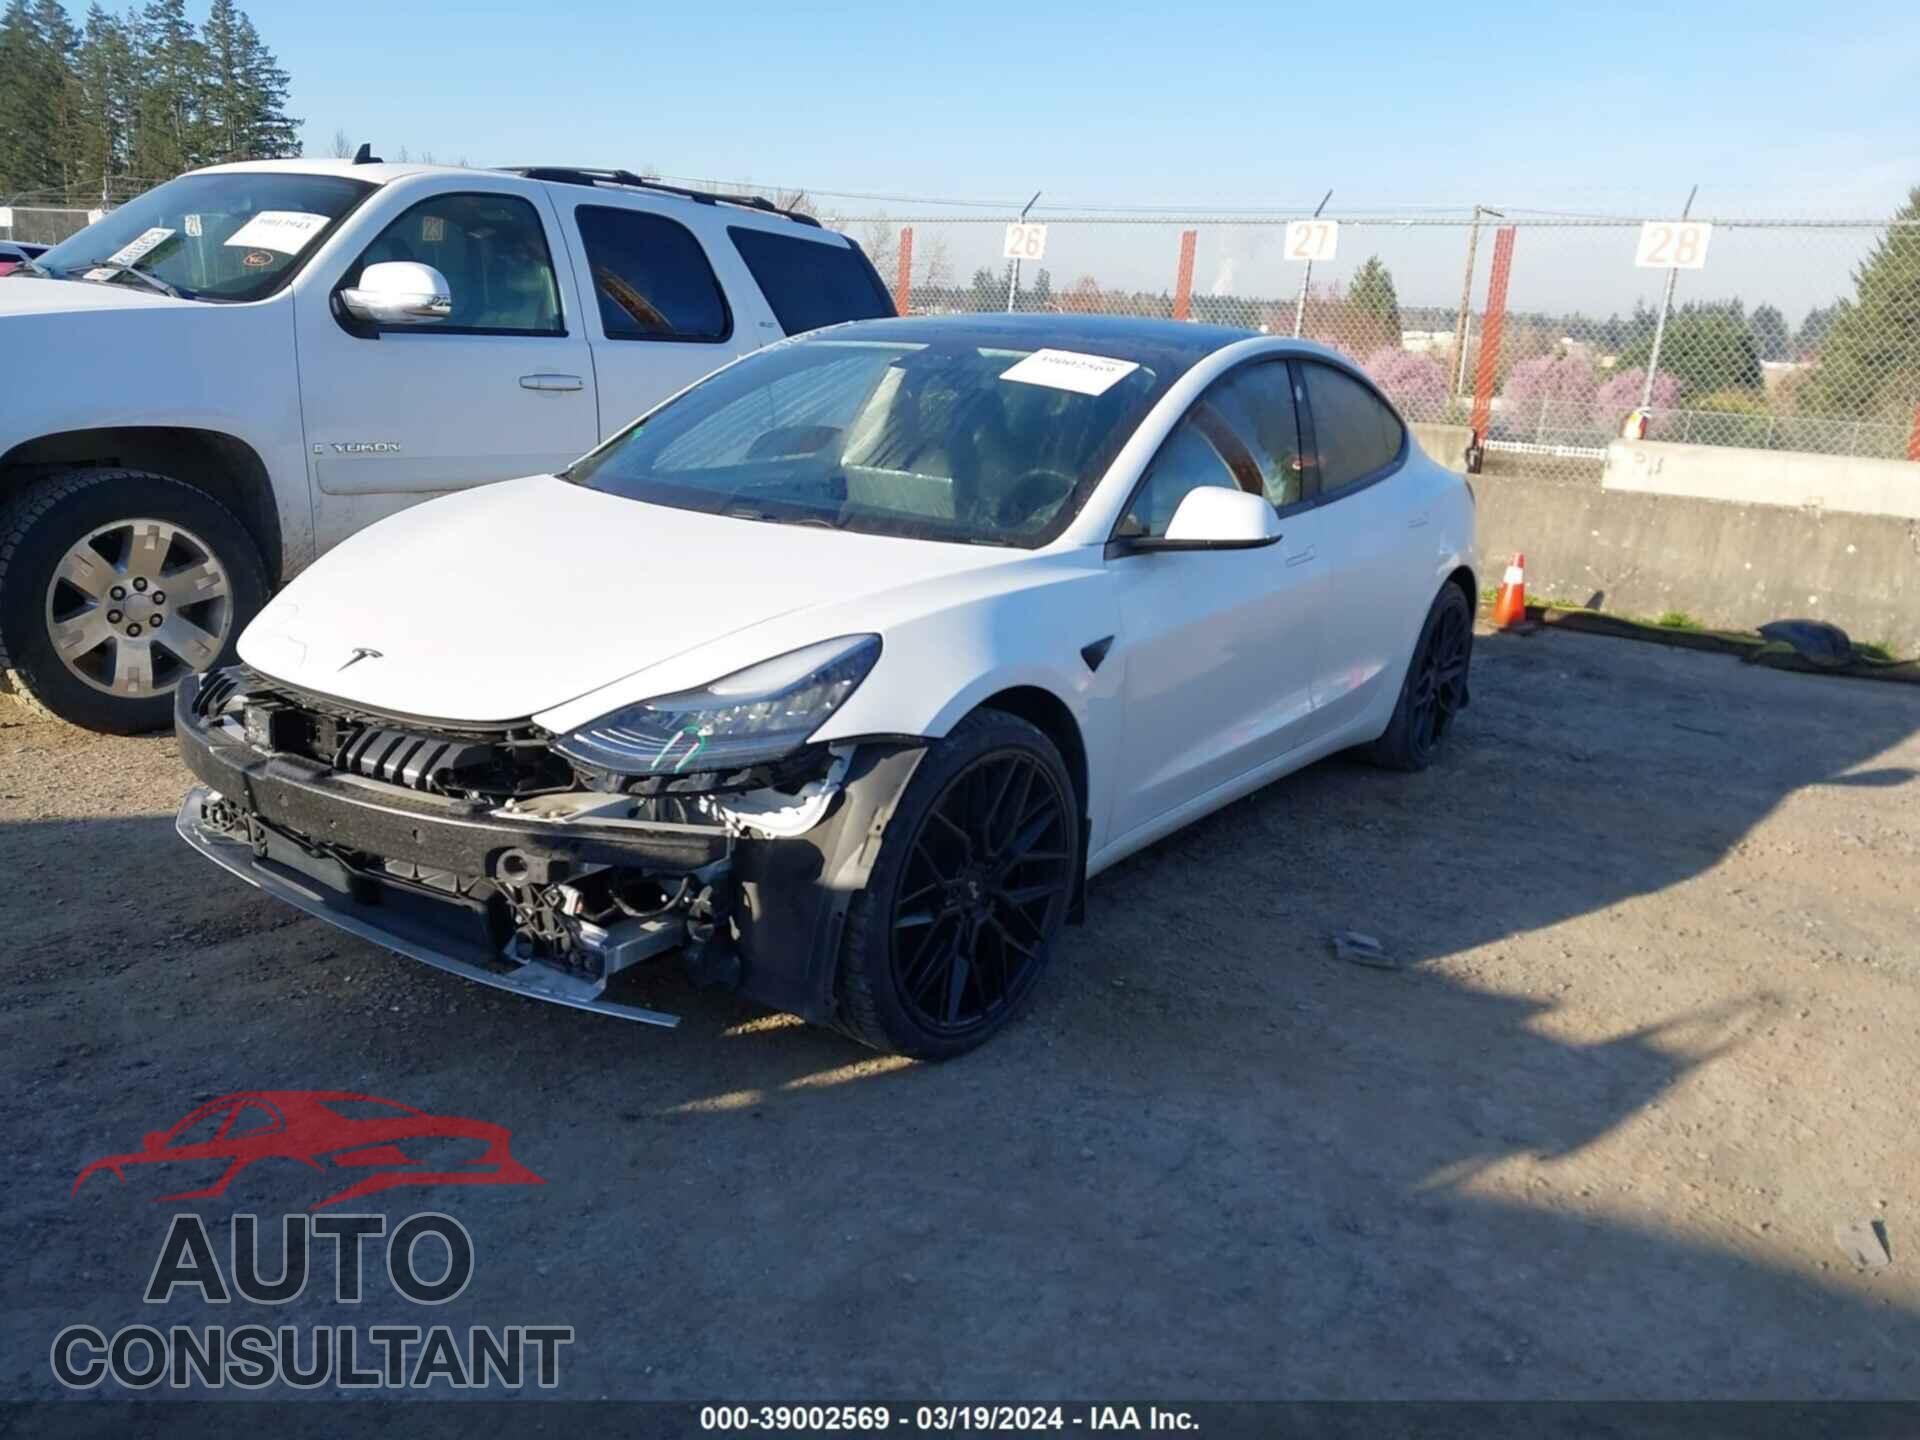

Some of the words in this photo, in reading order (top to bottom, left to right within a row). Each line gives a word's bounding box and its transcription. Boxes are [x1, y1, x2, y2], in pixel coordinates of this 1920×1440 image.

[1008, 226, 1041, 257] 26
[1293, 223, 1329, 257] 27
[1645, 225, 1701, 265] 28
[331, 442, 401, 454] YUKON
